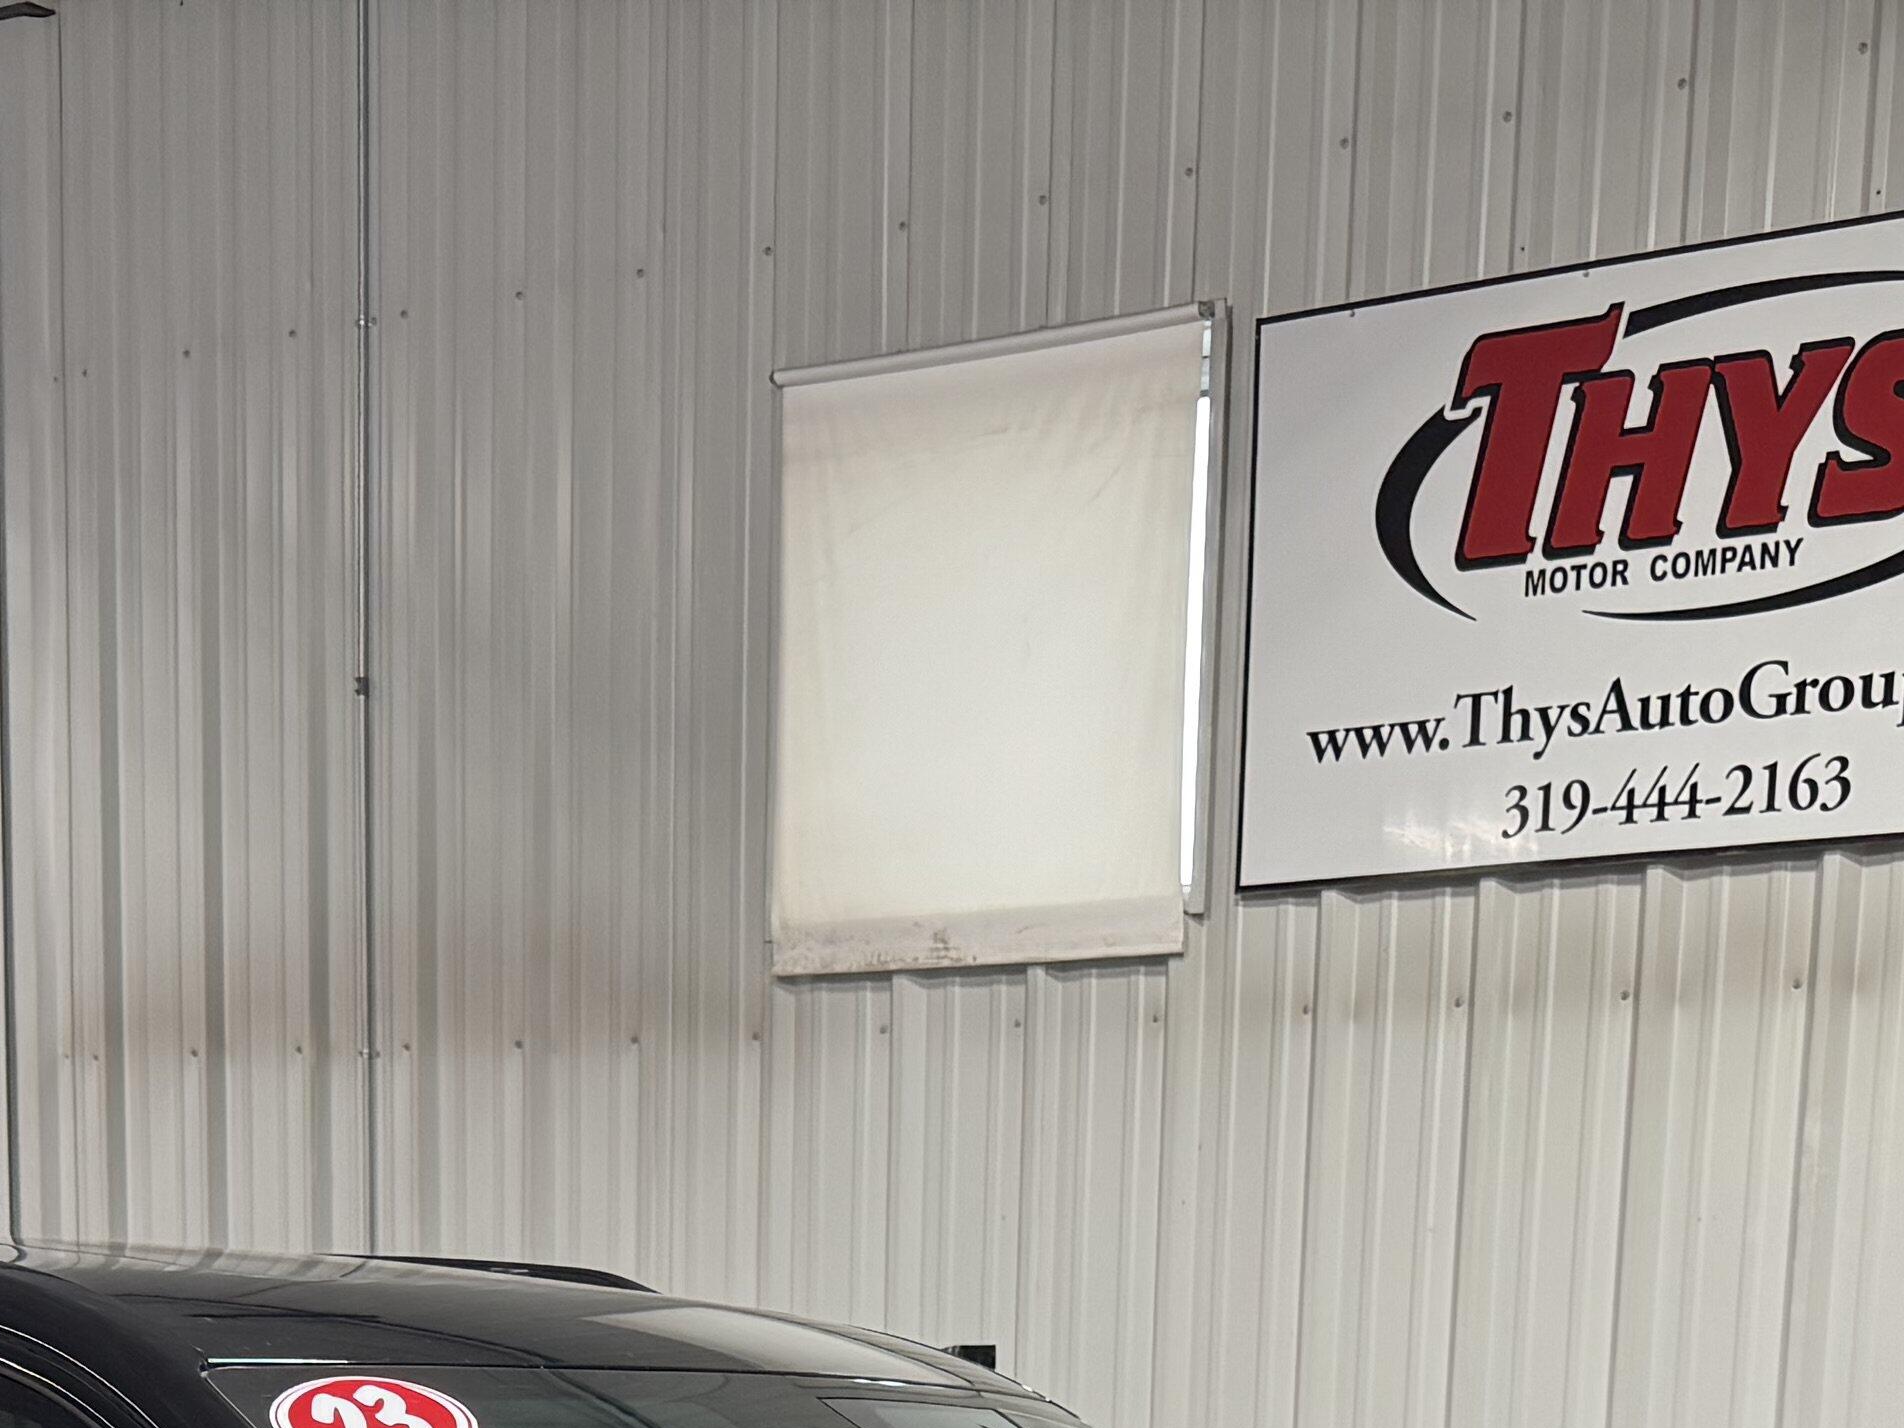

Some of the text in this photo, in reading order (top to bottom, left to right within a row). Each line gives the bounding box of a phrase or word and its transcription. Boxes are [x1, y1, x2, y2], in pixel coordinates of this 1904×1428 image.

[1523, 538, 1804, 598] MOTOR COMPANY
[1501, 754, 1853, 841] 319-444-2163
